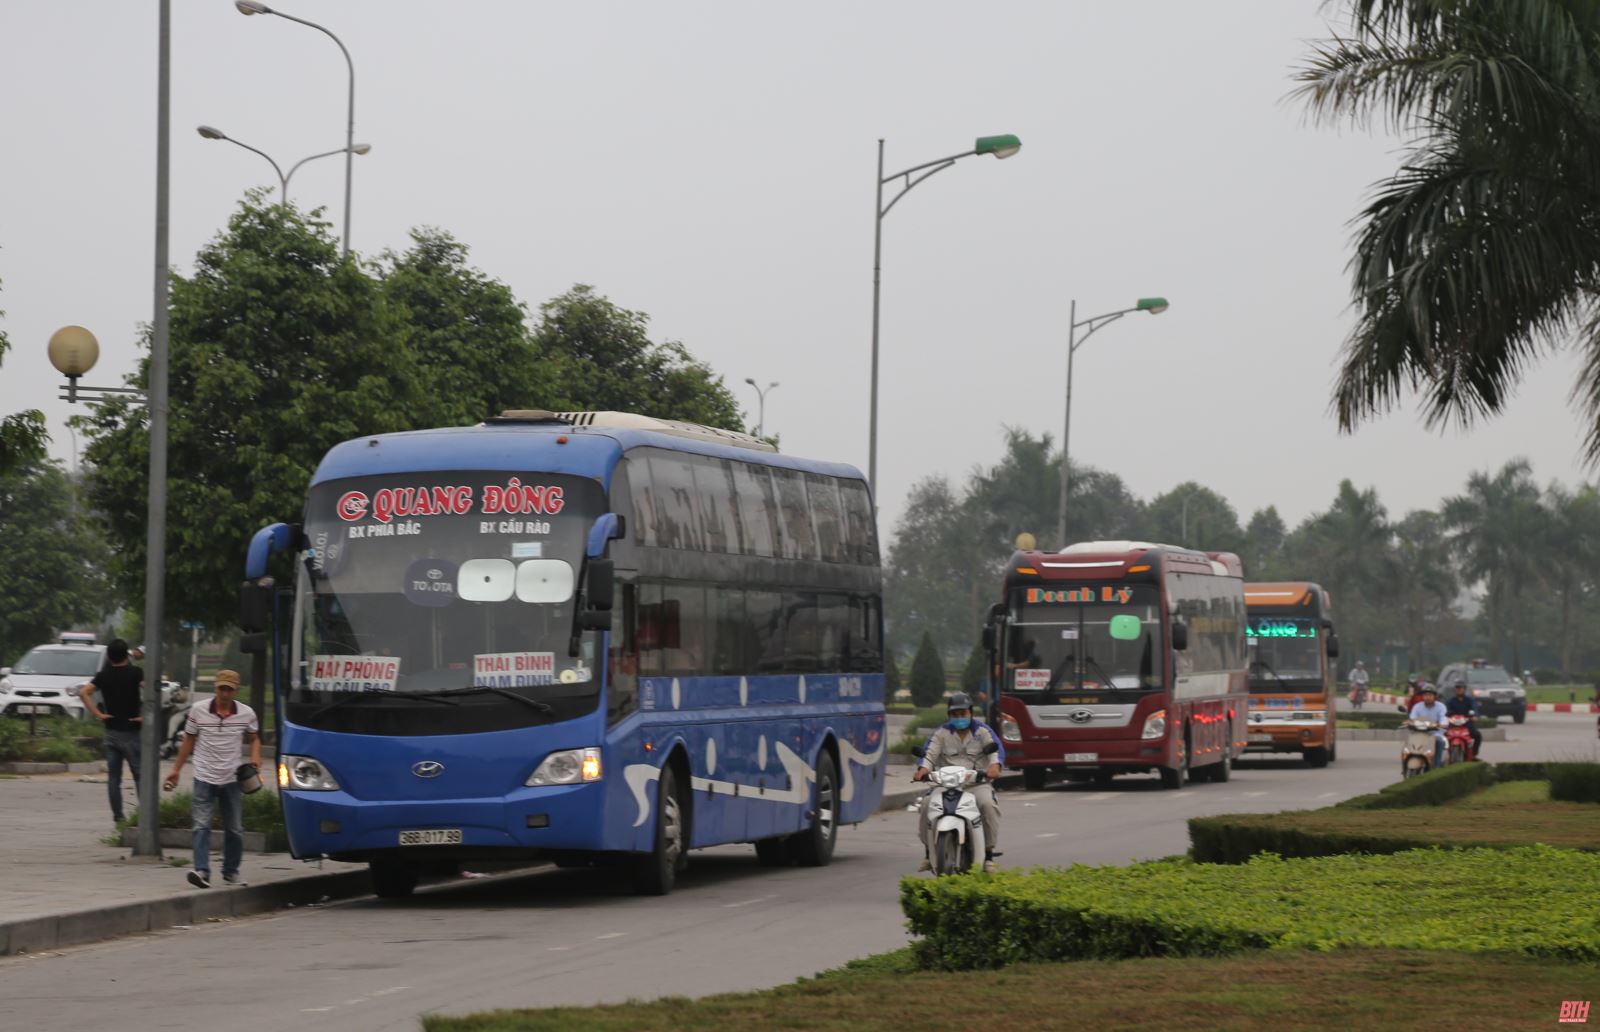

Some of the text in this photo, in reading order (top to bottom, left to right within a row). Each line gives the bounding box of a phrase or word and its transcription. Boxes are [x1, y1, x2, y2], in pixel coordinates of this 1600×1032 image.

[373, 477, 564, 523] QUANG ĐÔNG
[349, 525, 365, 538] BX
[480, 521, 496, 534] BX
[525, 519, 551, 534] RÀO
[312, 532, 328, 570] TOYOTA
[1027, 587, 1095, 603] Doanh
[342, 658, 396, 680] PHÒNG
[514, 653, 552, 671] BÌNH
[475, 675, 512, 688] NAM
